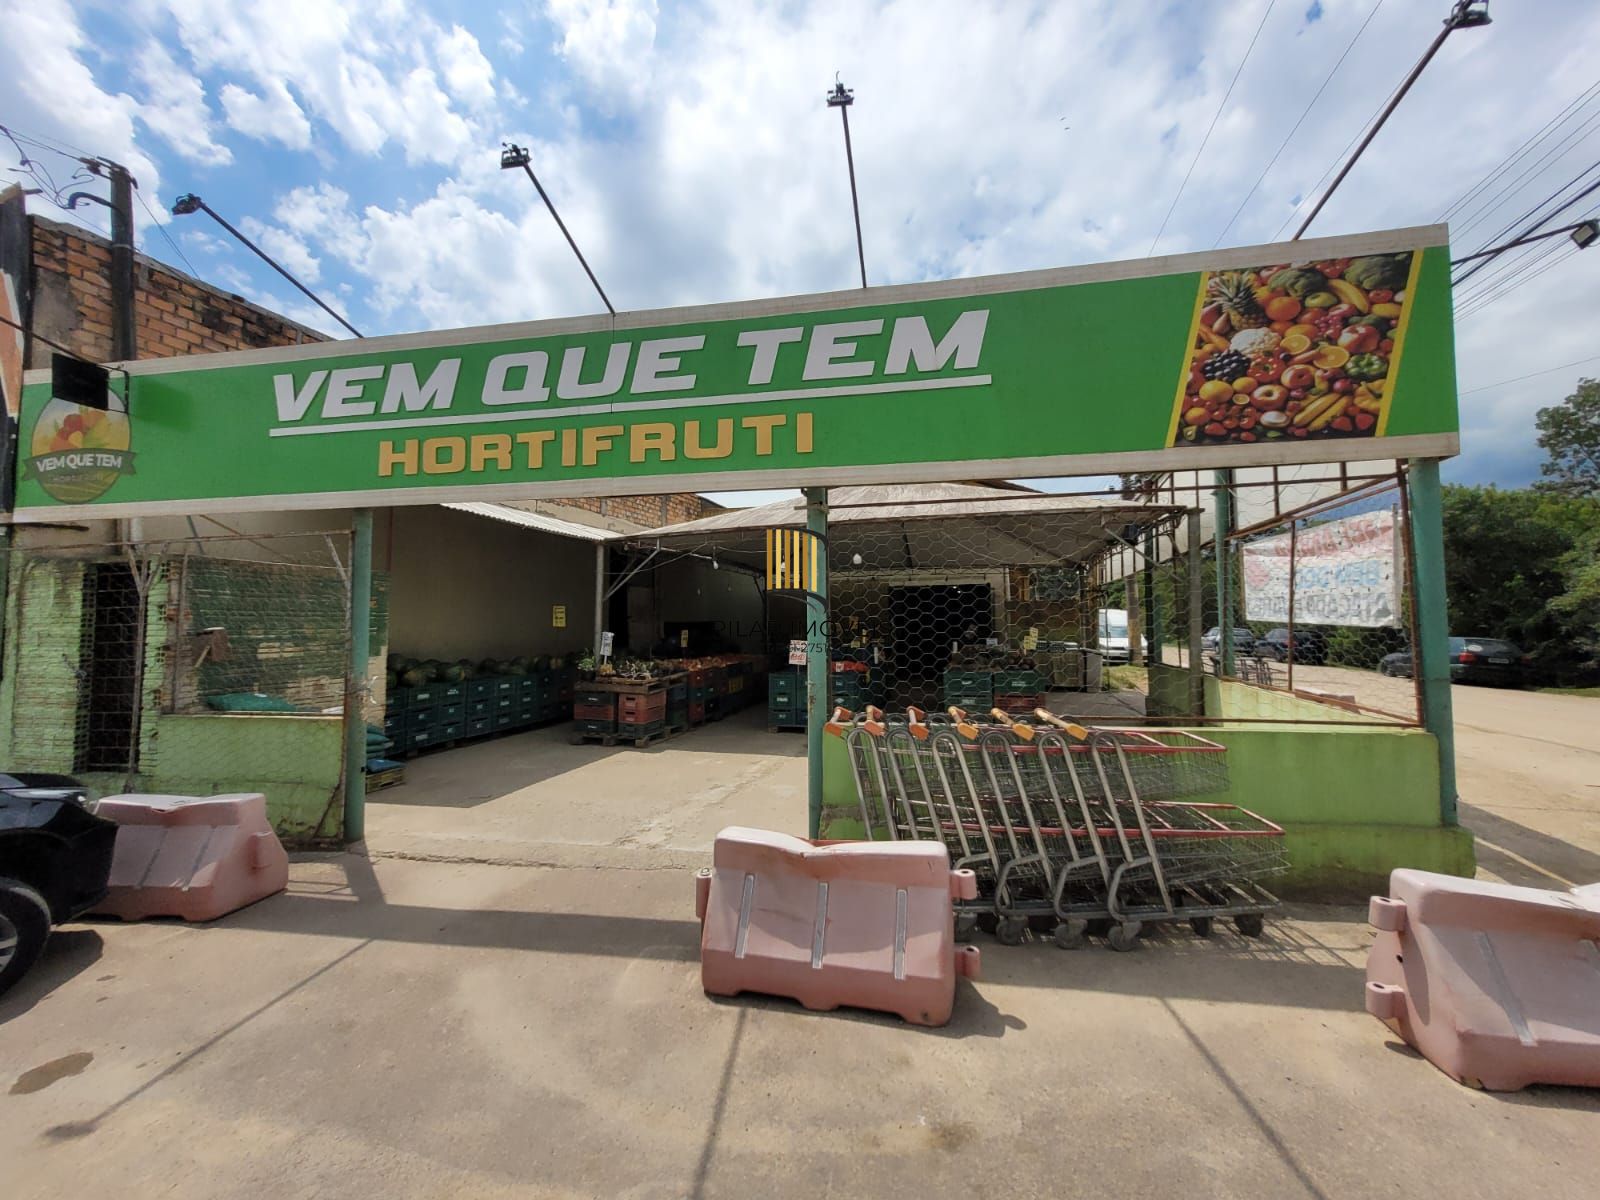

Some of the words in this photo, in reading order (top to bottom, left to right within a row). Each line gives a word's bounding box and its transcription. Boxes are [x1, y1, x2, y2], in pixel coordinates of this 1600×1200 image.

[272, 357, 462, 423] VEM
[480, 334, 707, 406] QUE
[736, 308, 990, 386] TEM
[36, 455, 65, 473] VEM
[66, 453, 95, 470] QUE
[95, 453, 123, 470] TEM
[378, 412, 813, 477] HORTIFRUTI
